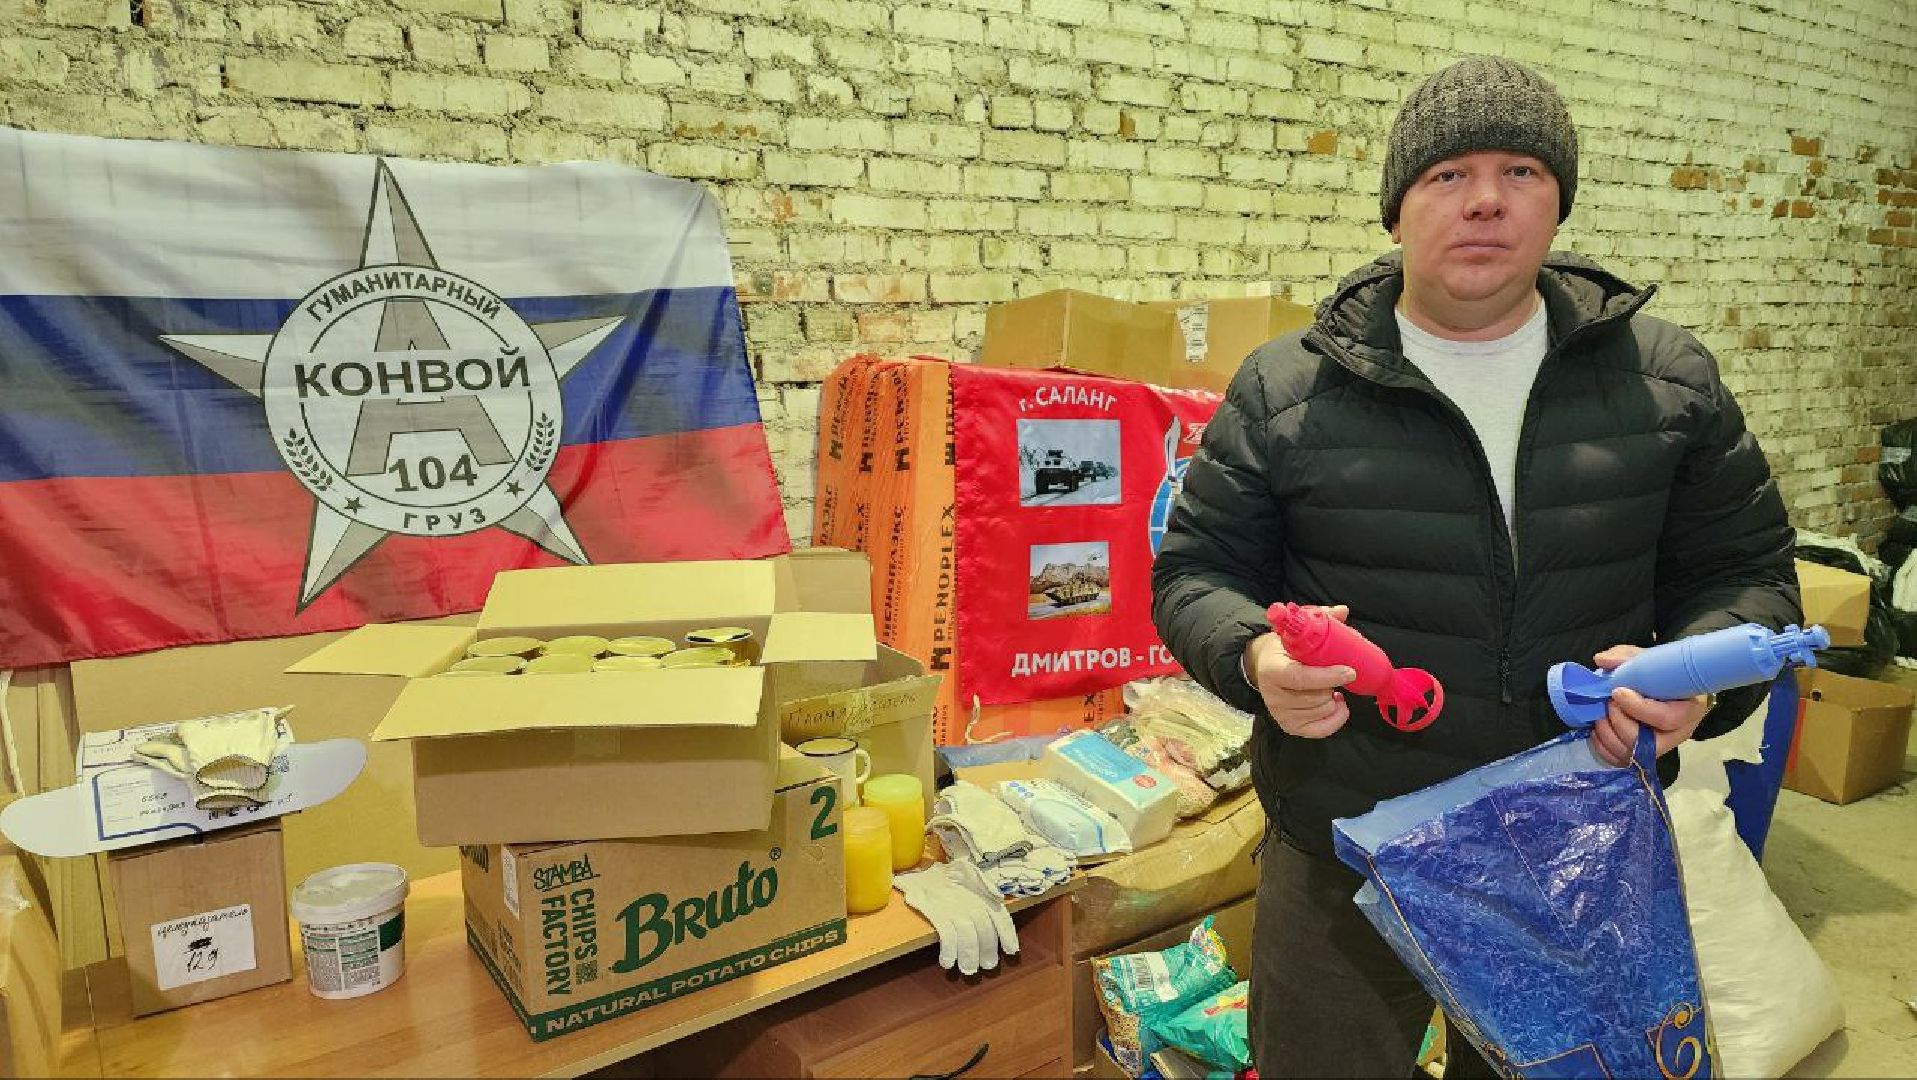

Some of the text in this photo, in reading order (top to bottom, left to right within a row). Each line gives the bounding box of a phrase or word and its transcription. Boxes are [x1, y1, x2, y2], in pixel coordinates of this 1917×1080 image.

[306, 271, 500, 322] ГУМАНИТАРНЫЙ
[294, 346, 530, 398] КОНВОЙ
[1035, 386, 1117, 411] САЛАНГ
[388, 454, 478, 492] 104
[404, 507, 486, 530] ГРУЗ
[934, 503, 954, 642] PENOPLEX
[1011, 647, 1131, 678] ДМИТРОВ
[810, 785, 838, 840] 2
[534, 853, 594, 890] STAMBA
[541, 894, 572, 995] FACTORY
[571, 888, 597, 960] CHIPS
[547, 929, 839, 1033] NATURAL POTATO CHIPS
